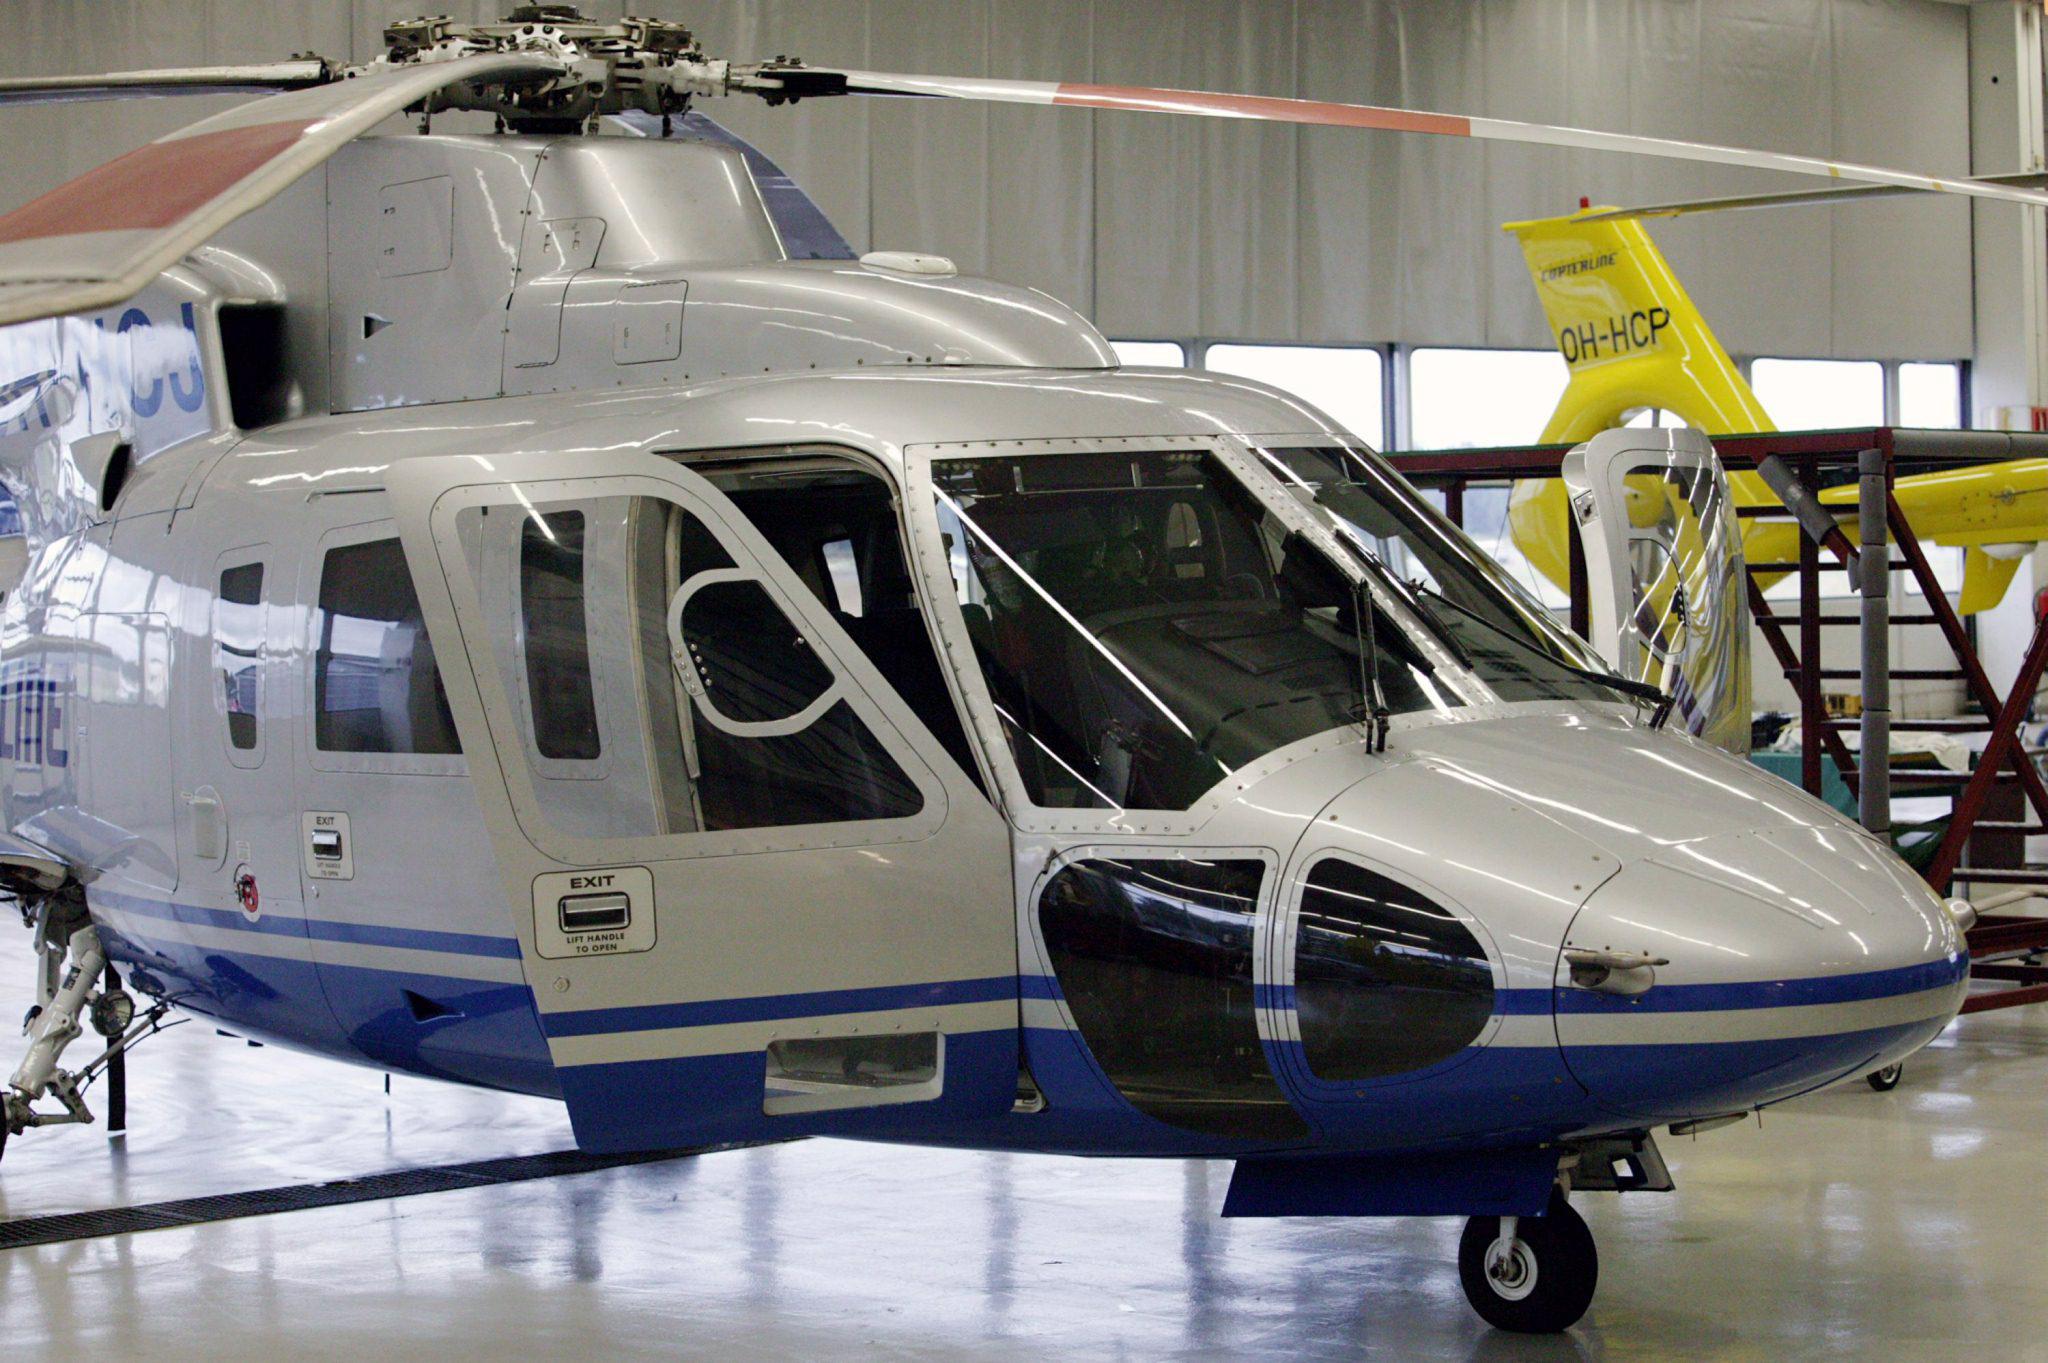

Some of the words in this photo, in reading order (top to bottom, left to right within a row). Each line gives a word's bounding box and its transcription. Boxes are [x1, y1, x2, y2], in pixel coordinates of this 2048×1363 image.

[1560, 307, 1670, 364] OH-HCP
[316, 816, 335, 825] EXIT
[570, 875, 615, 889] EXIT
[567, 936, 585, 944] LIFT
[587, 933, 625, 942] HANDLE
[576, 945, 589, 953] TO
[592, 943, 617, 952] OPEN
